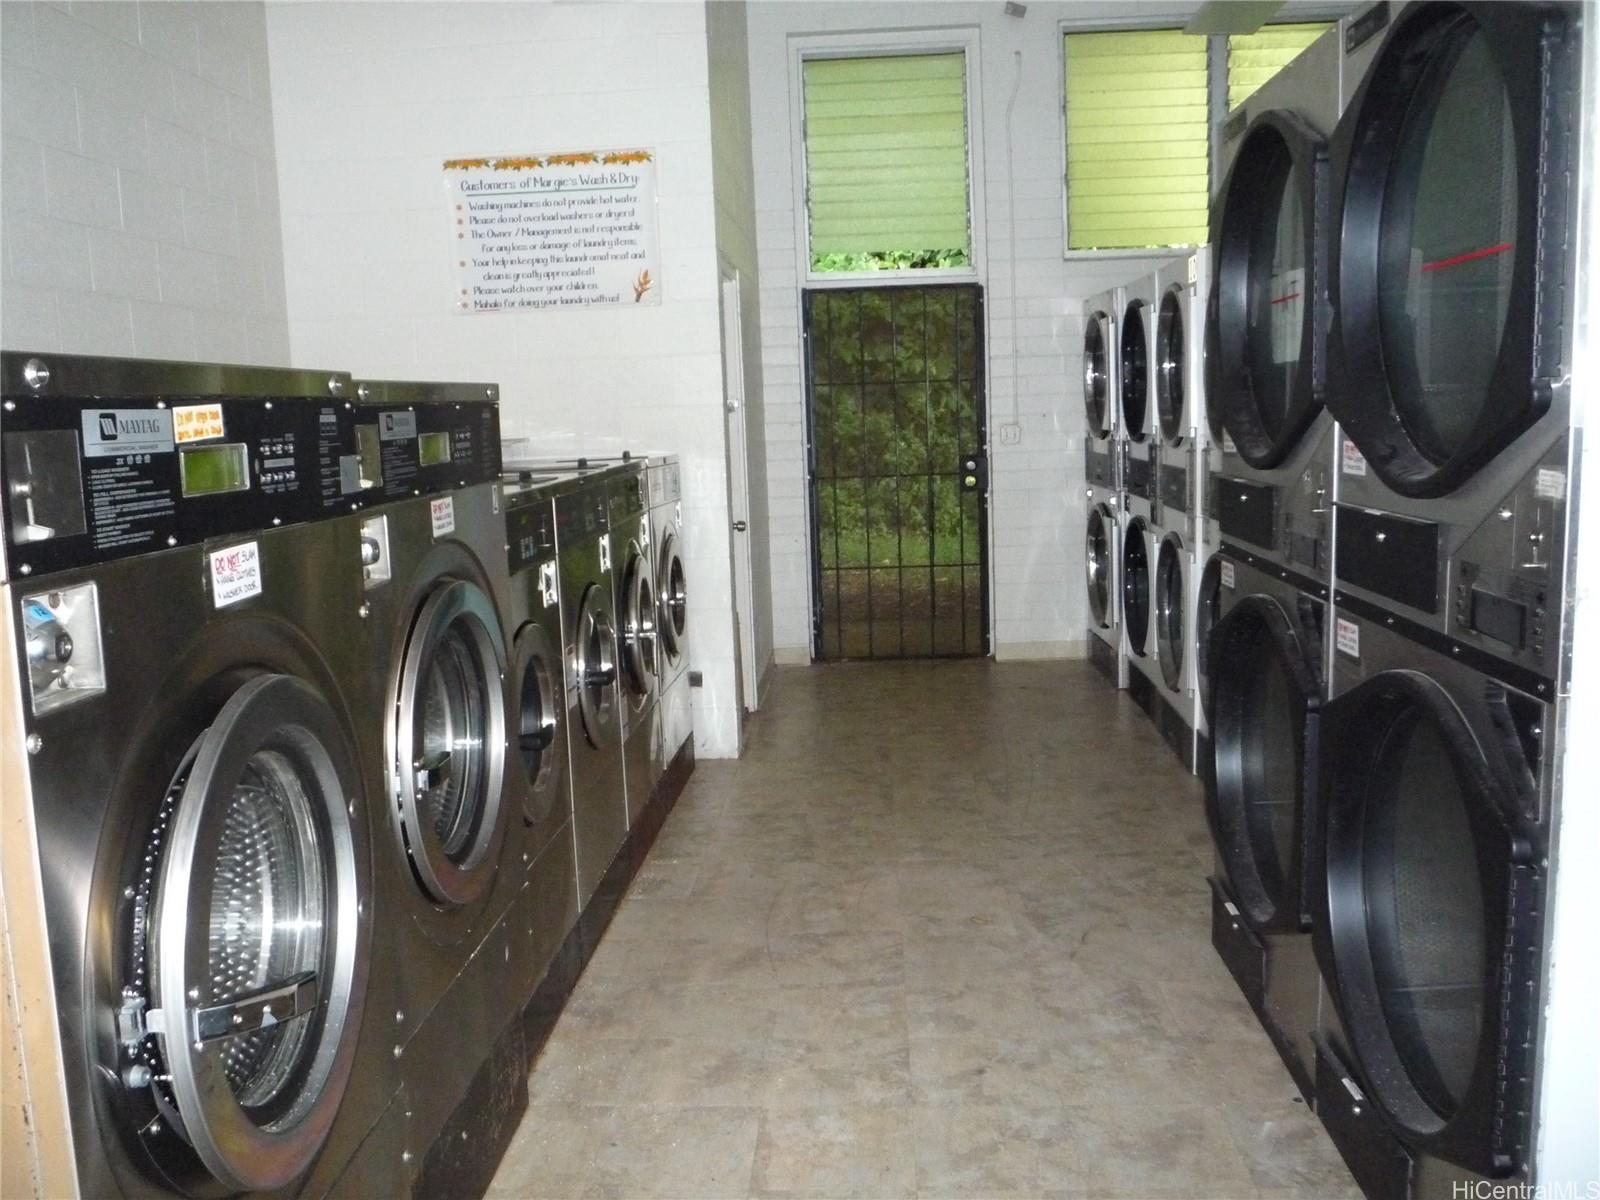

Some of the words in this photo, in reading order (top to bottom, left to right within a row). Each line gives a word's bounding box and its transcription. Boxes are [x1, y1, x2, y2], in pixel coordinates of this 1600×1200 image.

[460, 179, 516, 191] Customers
[520, 177, 532, 188] of
[533, 176, 577, 191] Margie's
[578, 173, 608, 185] Wash
[468, 201, 503, 212] Washing
[503, 199, 540, 210] machines
[542, 198, 552, 207] do
[553, 197, 566, 207] not
[567, 195, 599, 209] provide
[600, 195, 613, 204] hot
[469, 215, 496, 225] Please
[497, 215, 508, 224] do
[508, 213, 521, 223] not
[523, 211, 559, 222] overload
[560, 210, 593, 221] washers
[471, 229, 486, 239] The
[486, 228, 512, 239] Owner
[521, 225, 572, 239] Management
[574, 226, 580, 234] is
[581, 224, 594, 234] not
[596, 221, 642, 235] responsible
[481, 243, 494, 253] for
[496, 244, 511, 255] any
[511, 242, 528, 251] loss
[539, 240, 571, 251] damage
[572, 239, 581, 248] of
[583, 238, 613, 249] laundry
[472, 257, 489, 267] Your
[492, 257, 509, 269] help
[510, 258, 516, 266] in
[517, 255, 548, 267] keeping
[550, 254, 564, 263] this
[565, 252, 609, 262] laundromat
[610, 251, 629, 260] neat
[630, 249, 646, 259] and
[482, 271, 504, 281] clean
[513, 269, 542, 283] greatly
[543, 266, 595, 281] appreciated!
[473, 285, 500, 296] Please
[501, 284, 526, 294] watch
[545, 284, 563, 295] your
[474, 299, 502, 309] Mahalo
[503, 298, 515, 308] for
[518, 297, 540, 309] doing
[540, 298, 557, 309] your
[560, 295, 590, 306] laundry
[590, 293, 608, 303] with
[119, 418, 160, 435] MAYTAG
[215, 557, 225, 572] DO
[226, 551, 240, 569] NOT
